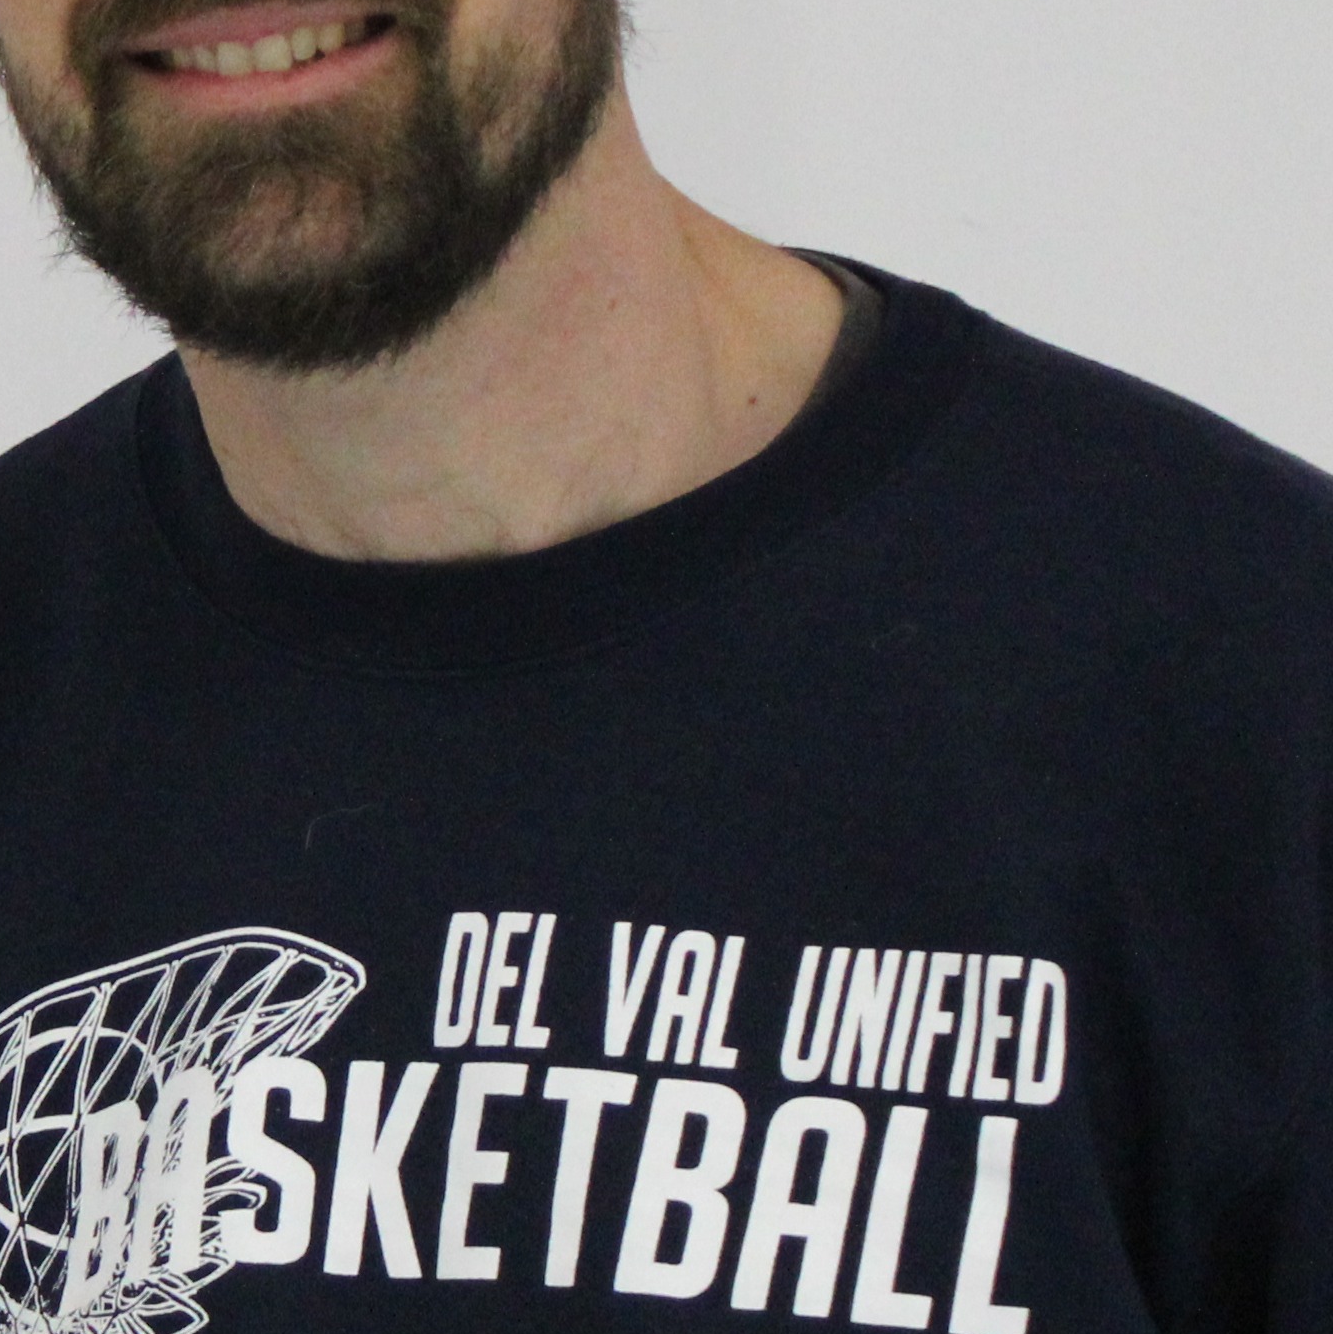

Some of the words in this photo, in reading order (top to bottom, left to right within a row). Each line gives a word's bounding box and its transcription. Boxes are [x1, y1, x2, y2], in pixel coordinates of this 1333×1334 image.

[433, 910, 557, 1050] DEL
[608, 920, 745, 1070] VAL
[779, 945, 1068, 1106] UNIFIED
